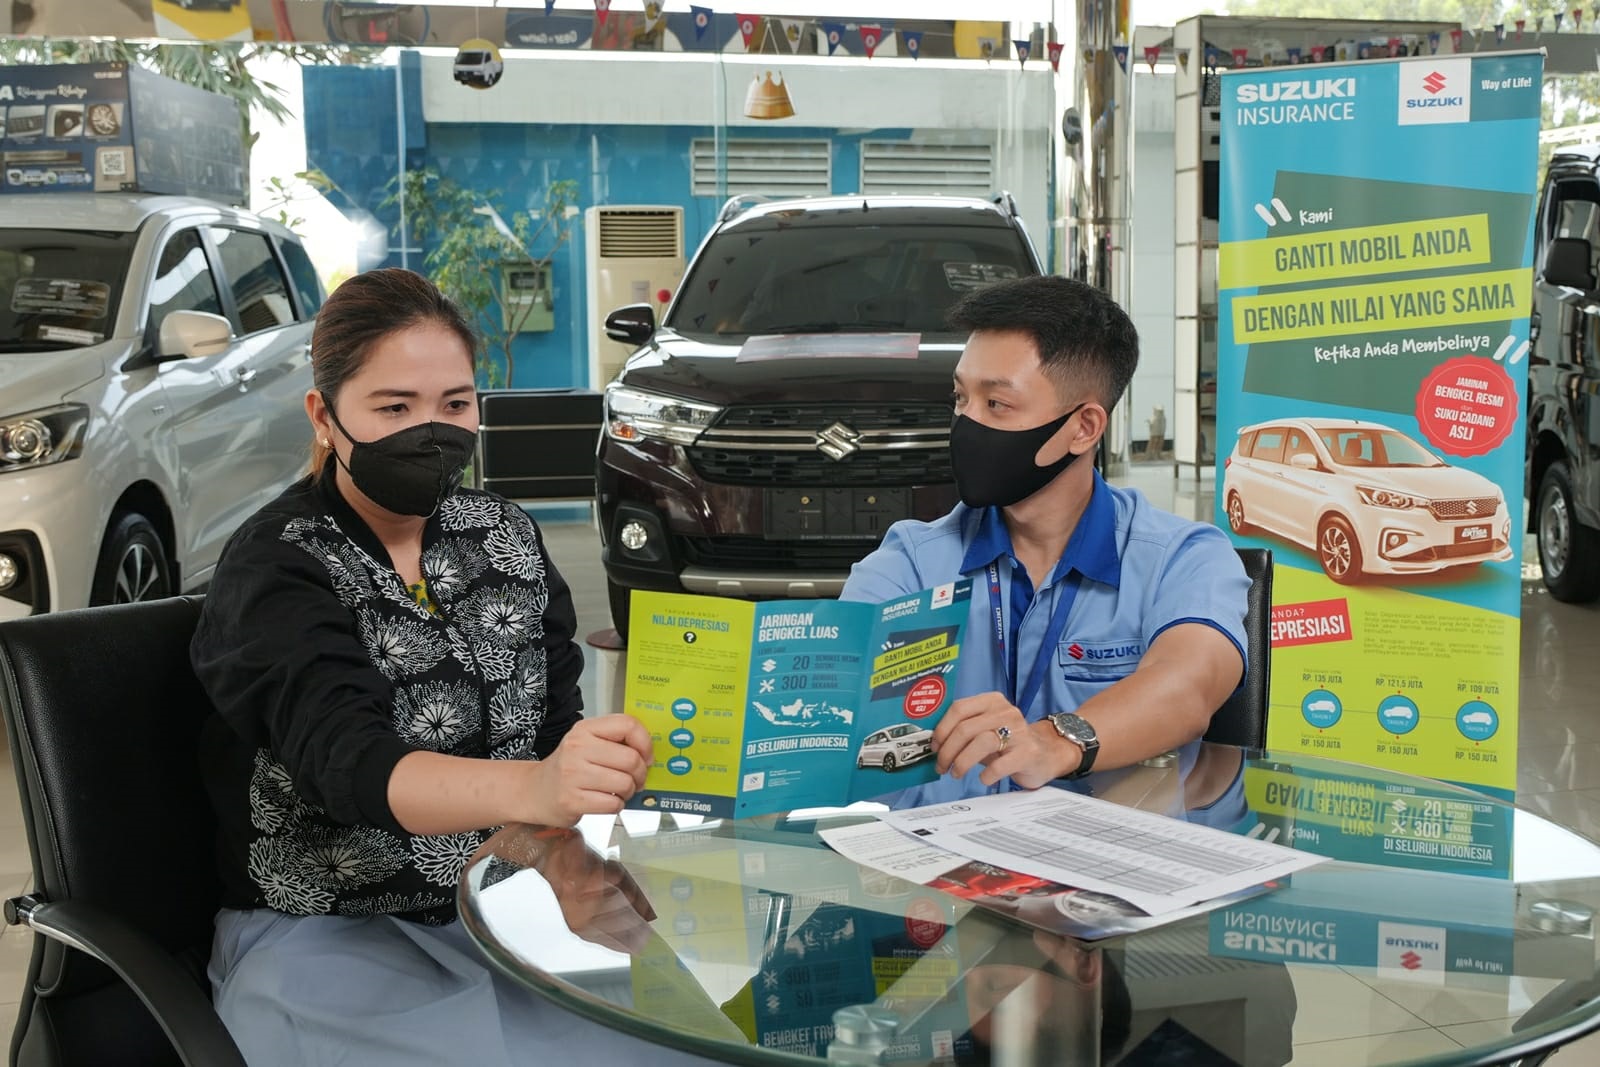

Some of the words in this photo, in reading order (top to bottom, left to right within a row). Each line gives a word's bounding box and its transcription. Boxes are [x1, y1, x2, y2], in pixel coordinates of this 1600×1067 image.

[1237, 78, 1356, 102] SUZUKI
[1482, 79, 1500, 90] Way
[1502, 78, 1511, 88] of
[1512, 77, 1532, 88] Life!
[1406, 96, 1462, 108] SUZUKI
[1237, 102, 1355, 126] INSURANCE
[1300, 208, 1332, 226] Kami
[1275, 246, 1333, 272] GANTI
[1340, 236, 1406, 266] MOBIL
[1412, 228, 1471, 258] ANDA
[1244, 303, 1324, 333] DENGAN
[1331, 296, 1384, 327] NILAI
[1390, 290, 1446, 319] YANG
[1452, 283, 1515, 314] SAMA
[1314, 344, 1361, 365] Ketika
[1364, 342, 1398, 358] Anda
[1402, 334, 1490, 354] Membelinya
[1456, 377, 1488, 390] JAMINAN
[1435, 386, 1474, 404] BENGKEL
[1475, 392, 1504, 408] RESMI
[1434, 407, 1458, 422] SUKU
[1458, 411, 1495, 428] CADANG
[1448, 426, 1474, 441] ASLI
[882, 598, 920, 614] SUZUKI
[1272, 608, 1304, 618] ANDA?
[652, 614, 676, 626] NILAI
[678, 616, 730, 632] DEPRESIASI
[760, 613, 813, 628] JARINGAN
[1271, 614, 1345, 640] EPRESIASI
[758, 628, 807, 642] BENGKEL
[810, 626, 839, 639] LUAS
[884, 652, 904, 664] GANTI
[904, 645, 923, 658] MOBIL
[924, 638, 942, 650] ANDA
[1086, 645, 1141, 660] SUZUKI
[792, 656, 810, 670] 20
[873, 669, 898, 684] DENGAN
[898, 664, 915, 676] NILAI
[916, 657, 932, 669] YANG
[934, 650, 951, 662] SAMA
[782, 676, 807, 690] 300
[1302, 673, 1313, 681] RP.
[1314, 674, 1326, 682] 135
[1328, 676, 1342, 684] JUTA
[1376, 678, 1386, 686] RP.
[1408, 680, 1423, 689] JUTA
[1457, 684, 1468, 692] RP.
[1484, 686, 1500, 694] JUTA
[746, 744, 756, 756] DI
[758, 739, 798, 754] SELURUH
[800, 737, 848, 748] INDONESIA
[1301, 738, 1311, 746] RP.
[1313, 740, 1324, 748] 150
[1326, 740, 1341, 749] JUTA
[1390, 746, 1401, 754] 150
[1402, 747, 1418, 756] JUTA
[1456, 752, 1466, 760] RP.
[1468, 752, 1480, 761] 150
[1482, 754, 1498, 762] JUTA
[1314, 779, 1375, 799] JARINGAN
[1424, 800, 1441, 817] 20
[1341, 820, 1374, 837] LUAS
[1414, 820, 1440, 838] 300
[1384, 838, 1394, 850] DI
[1395, 839, 1438, 856] SELURUH
[1440, 844, 1492, 861] INDONESIA
